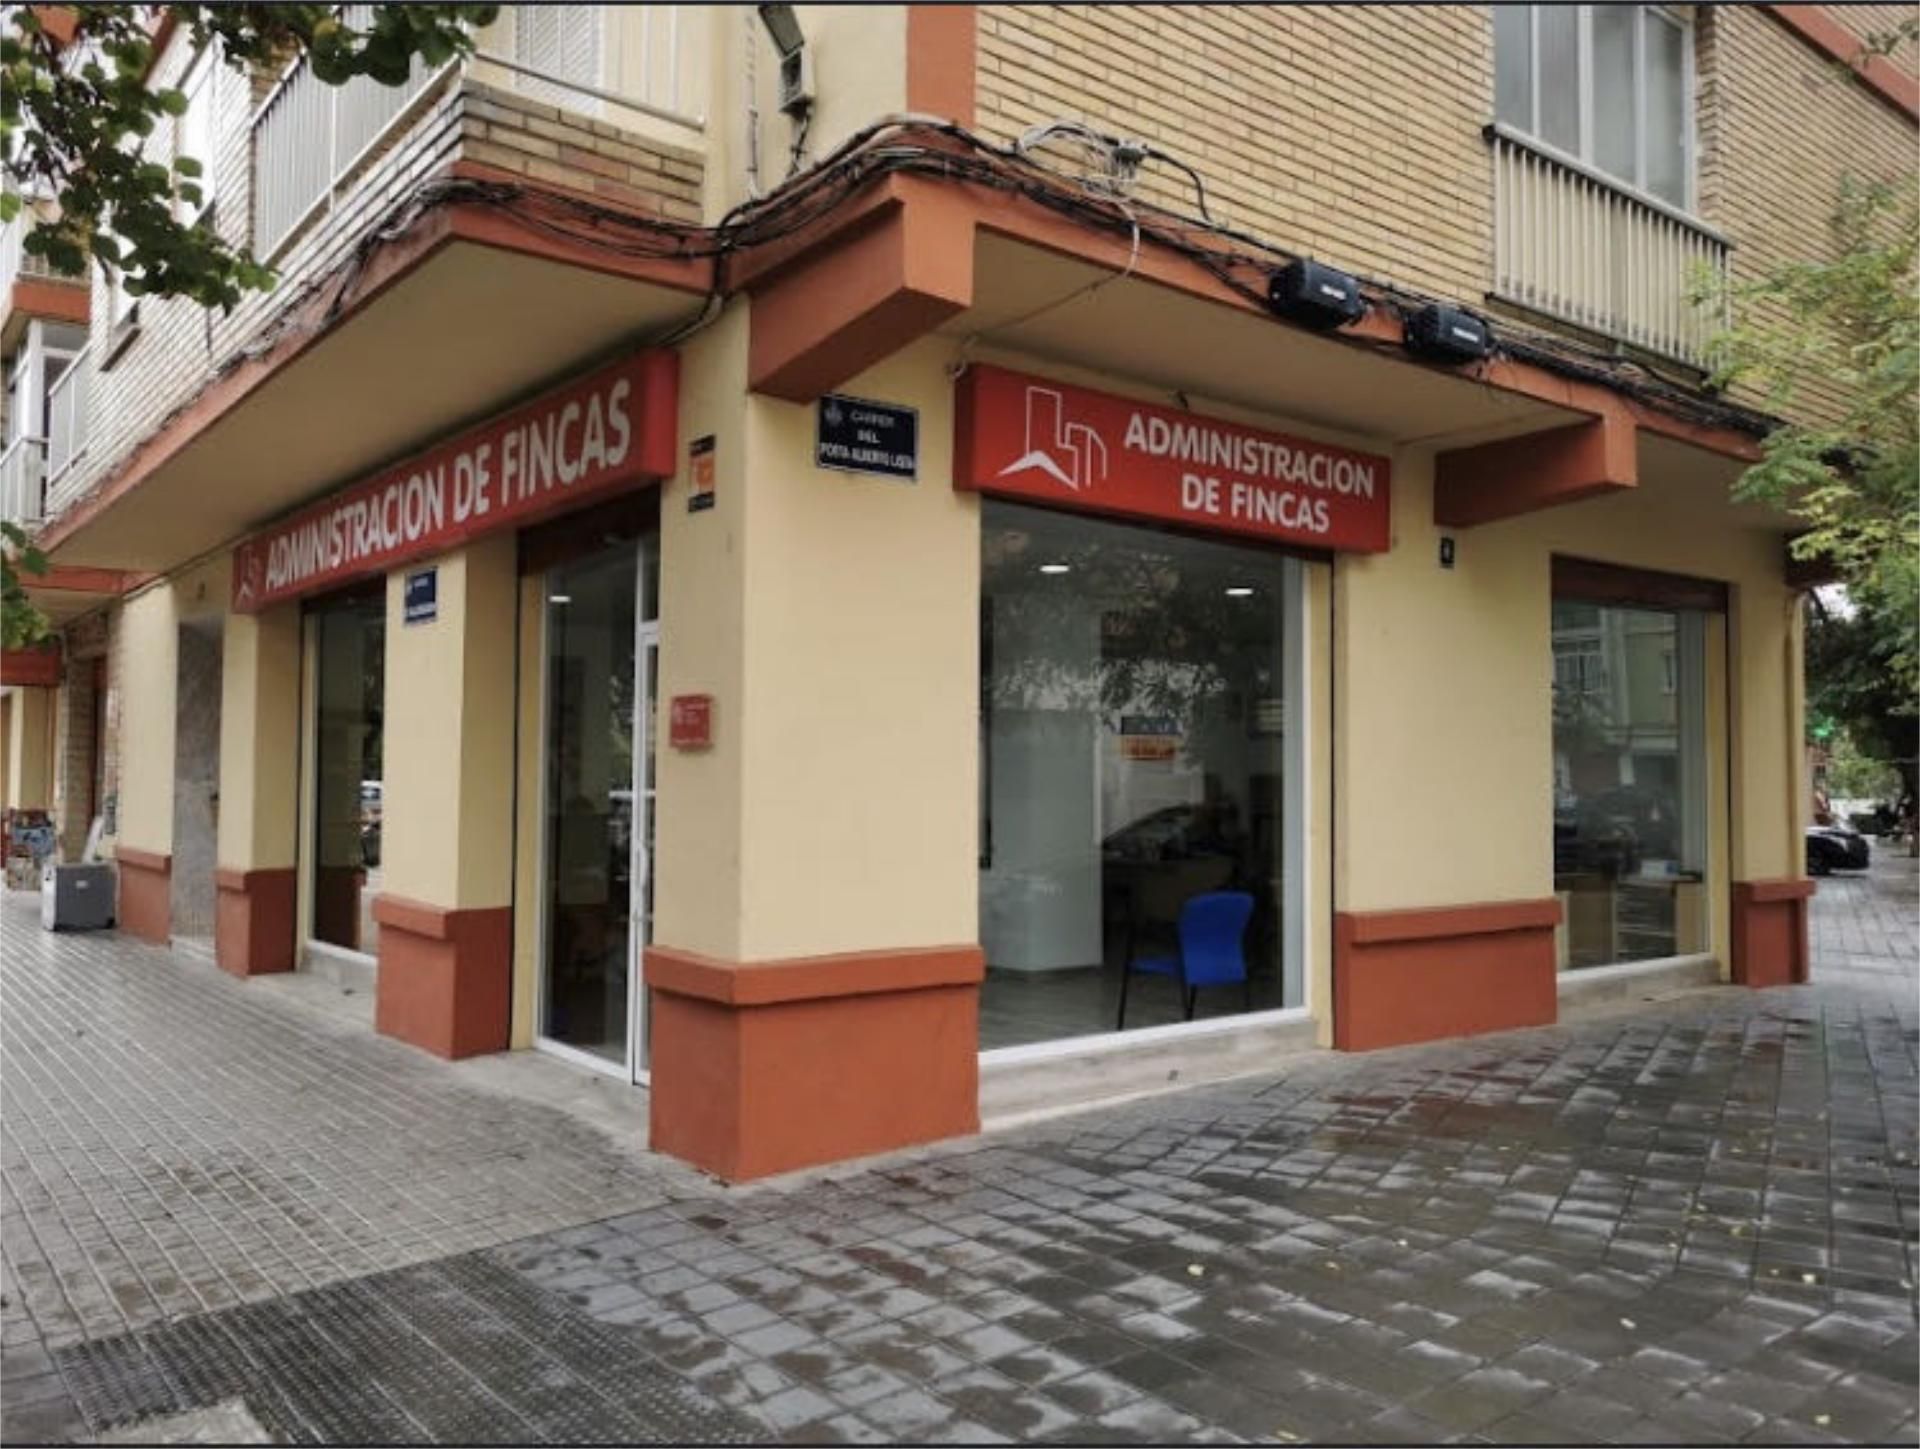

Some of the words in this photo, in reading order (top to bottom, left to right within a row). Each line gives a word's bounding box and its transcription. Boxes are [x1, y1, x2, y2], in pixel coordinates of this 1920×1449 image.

[265, 464, 444, 592] ADMINISTRACION
[453, 444, 491, 522] DE
[502, 378, 631, 507] FINCAS
[1122, 411, 1374, 498] ADMINISTRACION
[1181, 473, 1221, 515] DE
[1231, 483, 1330, 534] FINCAS
